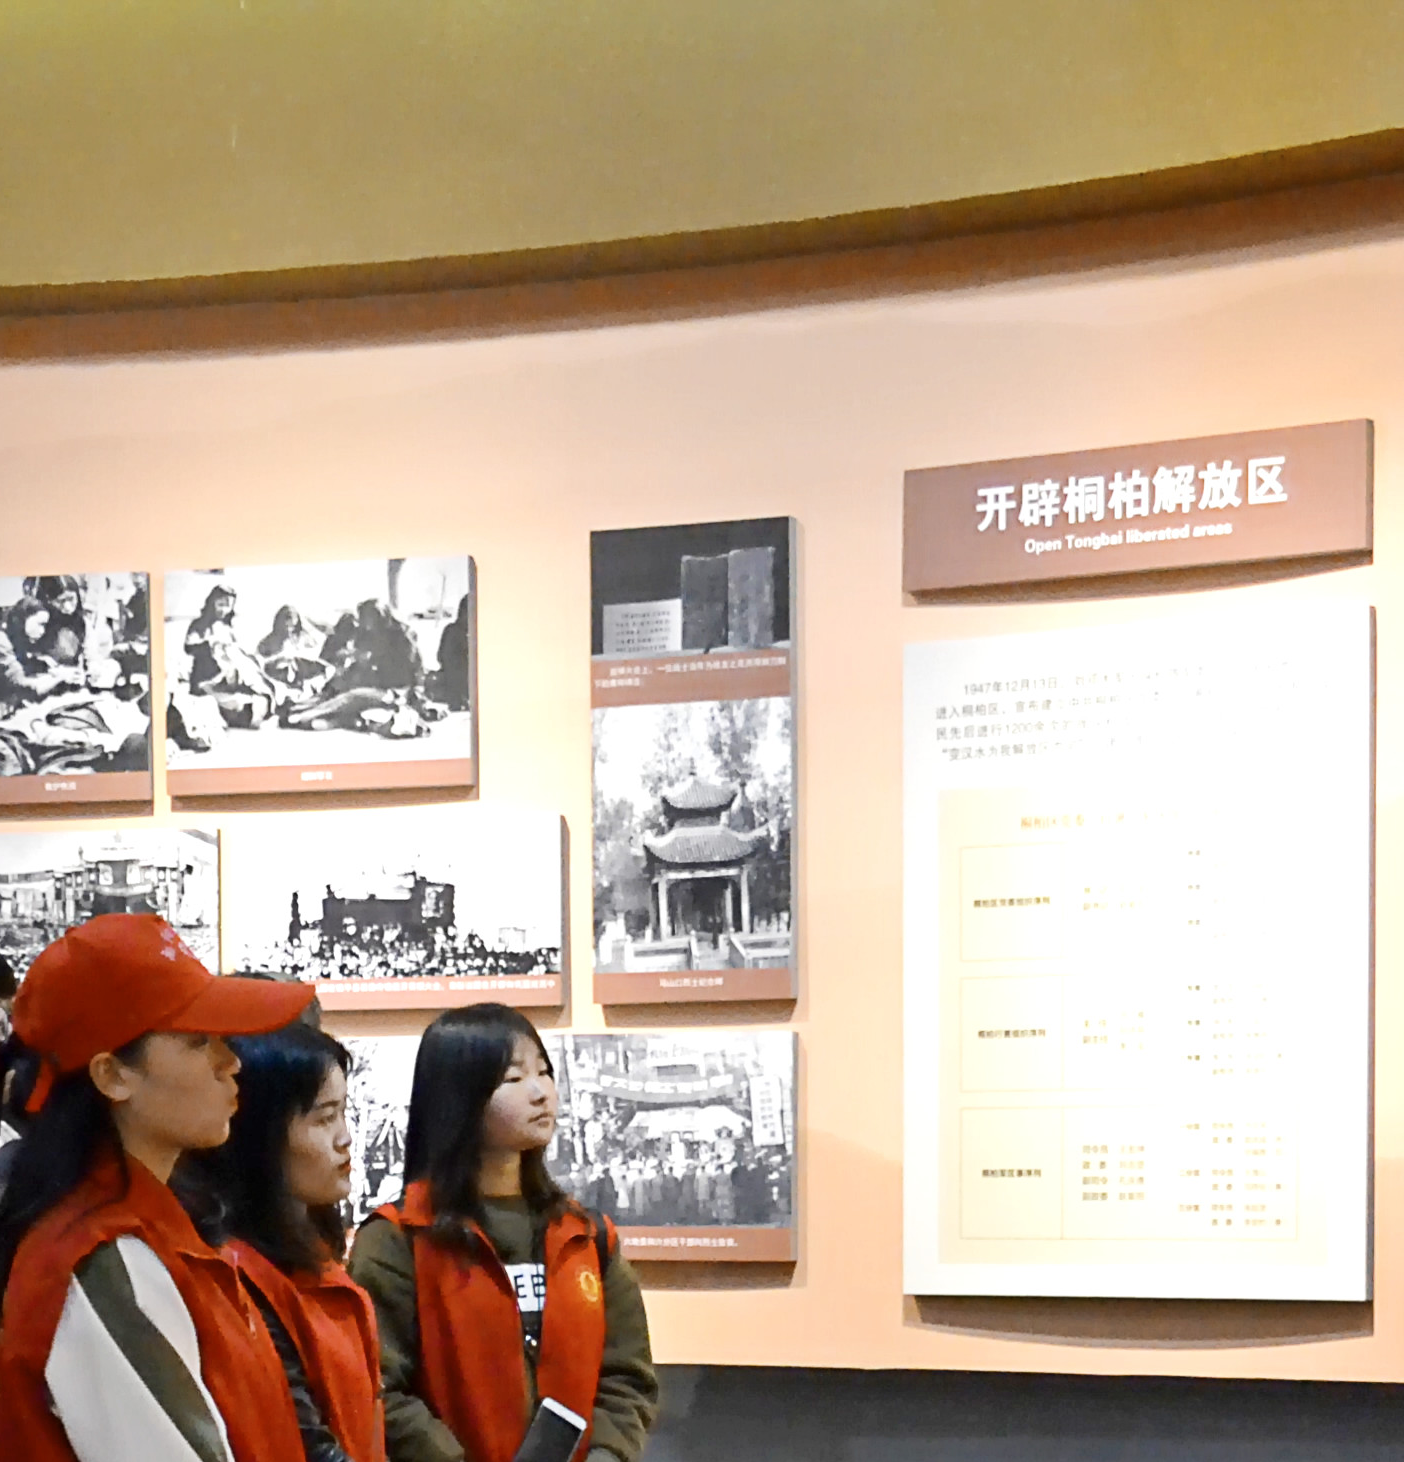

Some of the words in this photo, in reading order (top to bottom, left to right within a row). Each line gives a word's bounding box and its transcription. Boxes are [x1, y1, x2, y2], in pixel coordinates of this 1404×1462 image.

[975, 455, 1288, 532] 开辟桐柏解放区
[1024, 537, 1062, 555] Open
[1066, 530, 1123, 551] Tongbai
[1125, 524, 1190, 545] liberated
